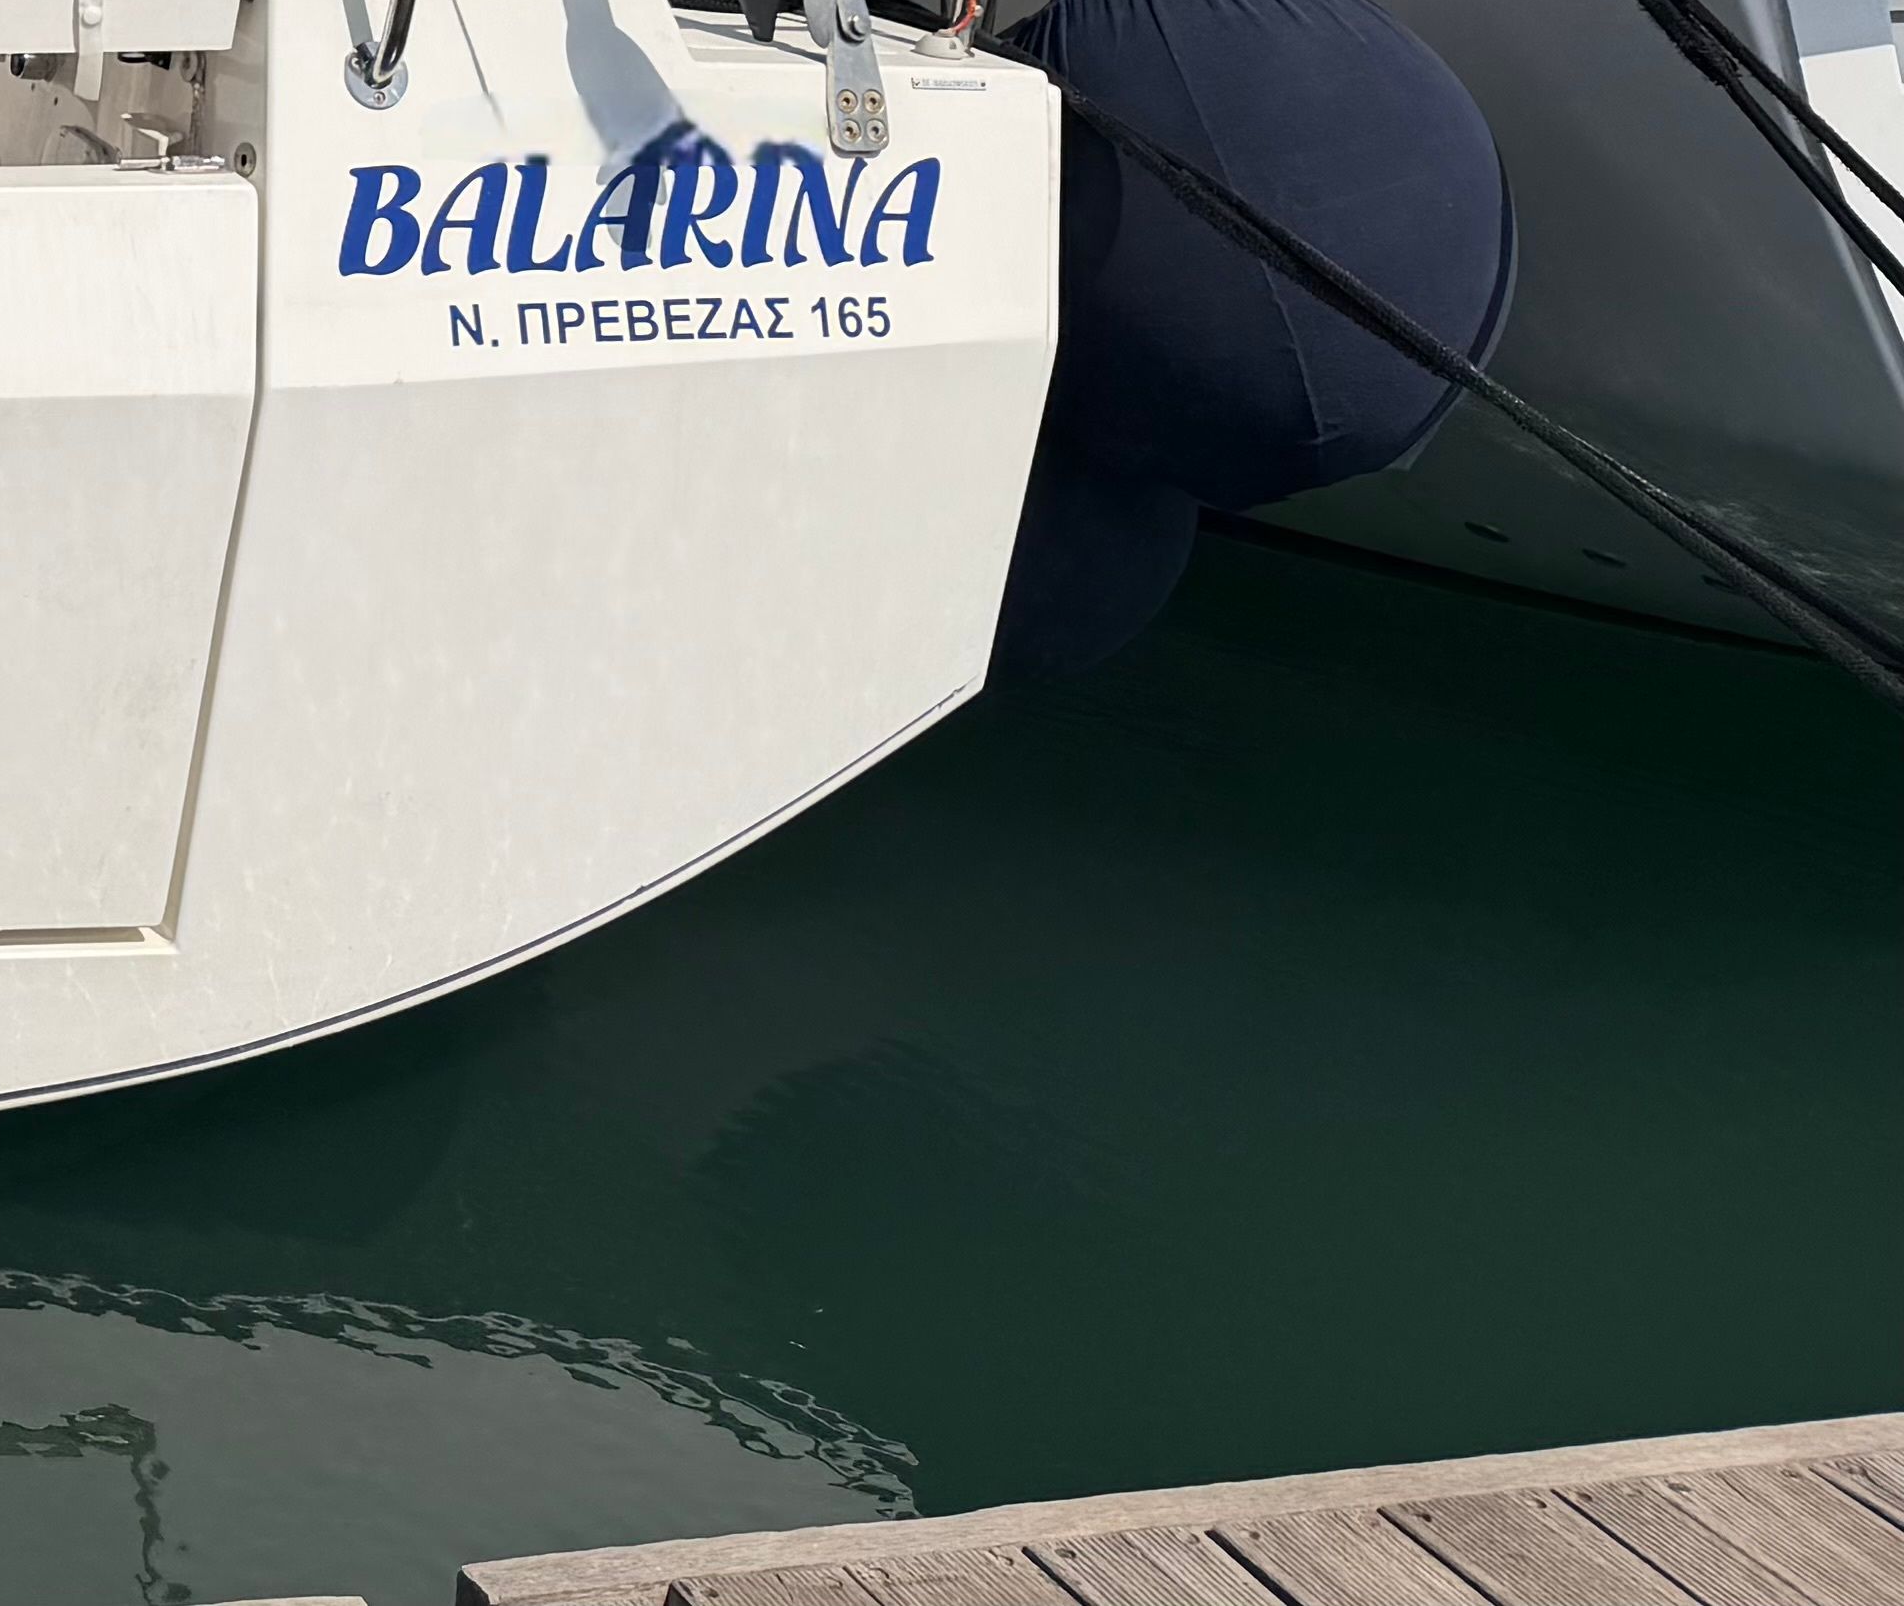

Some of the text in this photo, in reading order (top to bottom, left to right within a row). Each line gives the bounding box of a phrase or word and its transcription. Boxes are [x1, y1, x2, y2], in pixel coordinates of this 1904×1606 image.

[339, 156, 942, 277] BALARINA
[517, 297, 794, 345] ΠΡΕΒΕΖΑΣ
[810, 296, 892, 339] 165
